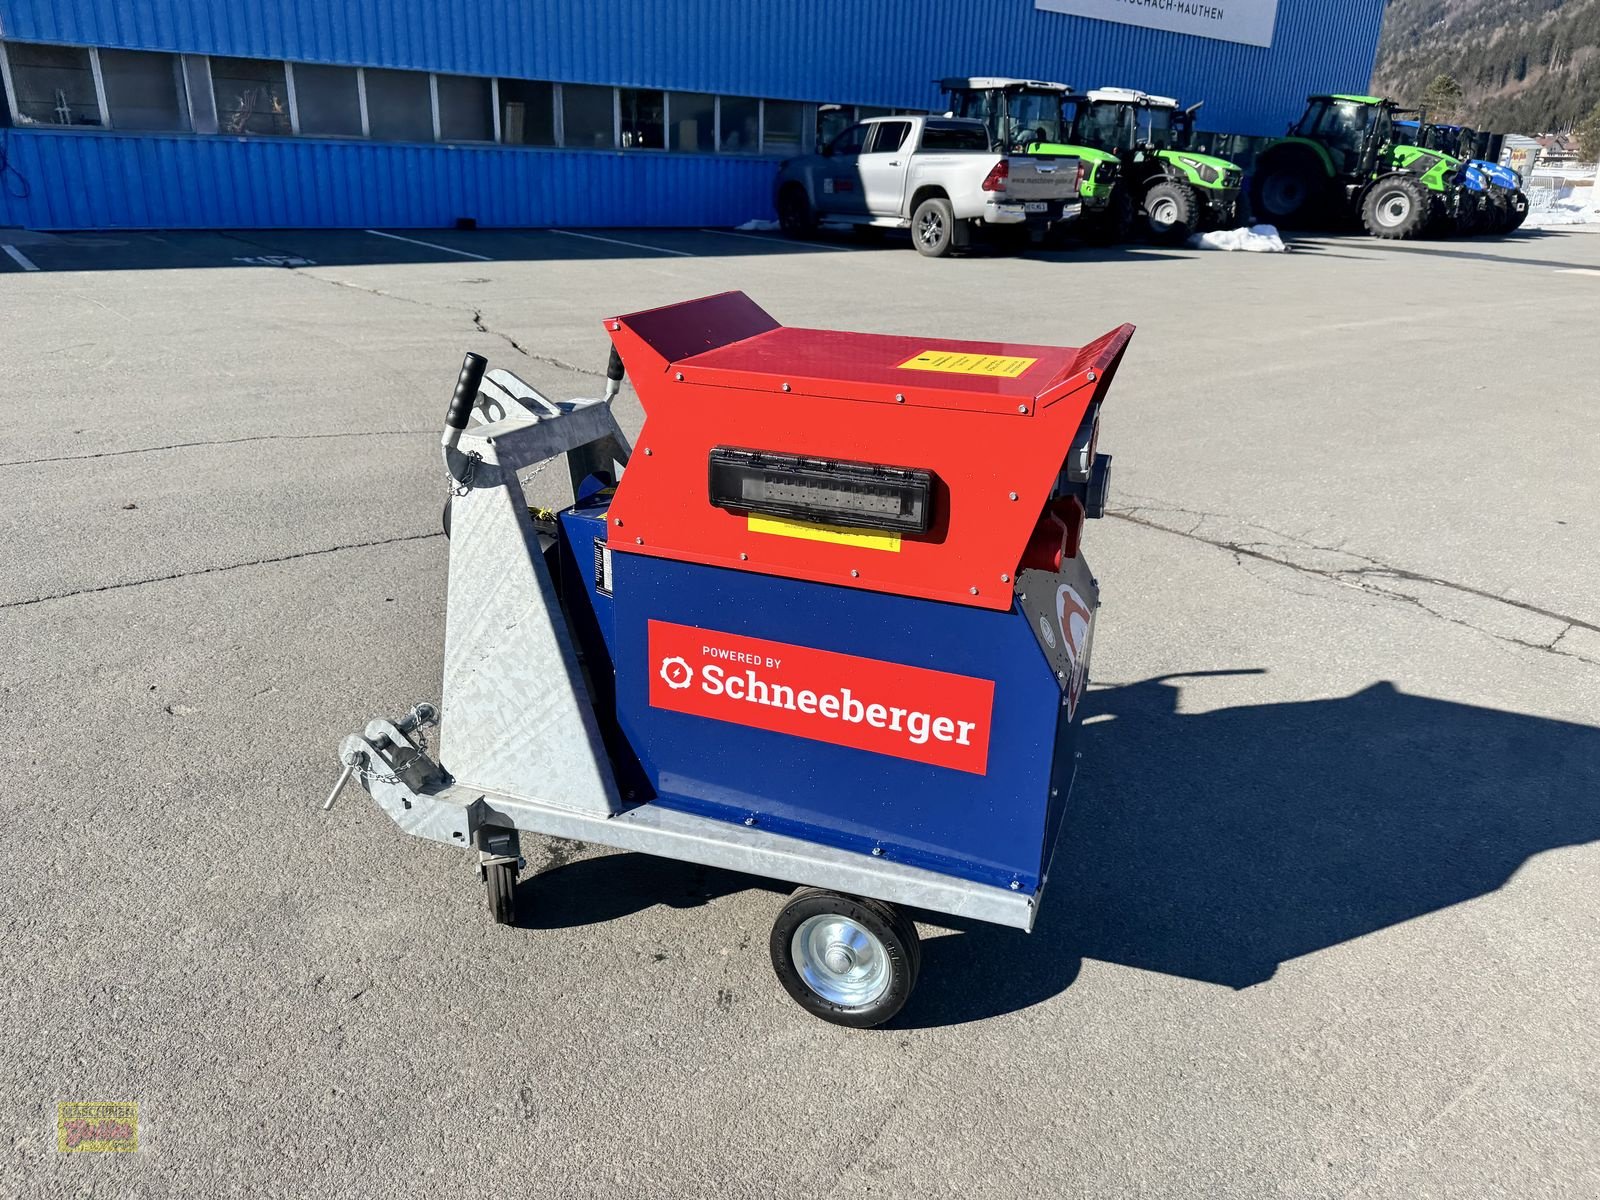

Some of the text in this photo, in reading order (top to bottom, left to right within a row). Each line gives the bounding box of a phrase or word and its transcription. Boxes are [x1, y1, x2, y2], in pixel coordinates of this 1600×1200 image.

[702, 645, 781, 669] POWERED BY
[701, 664, 976, 746] Schneeberger
